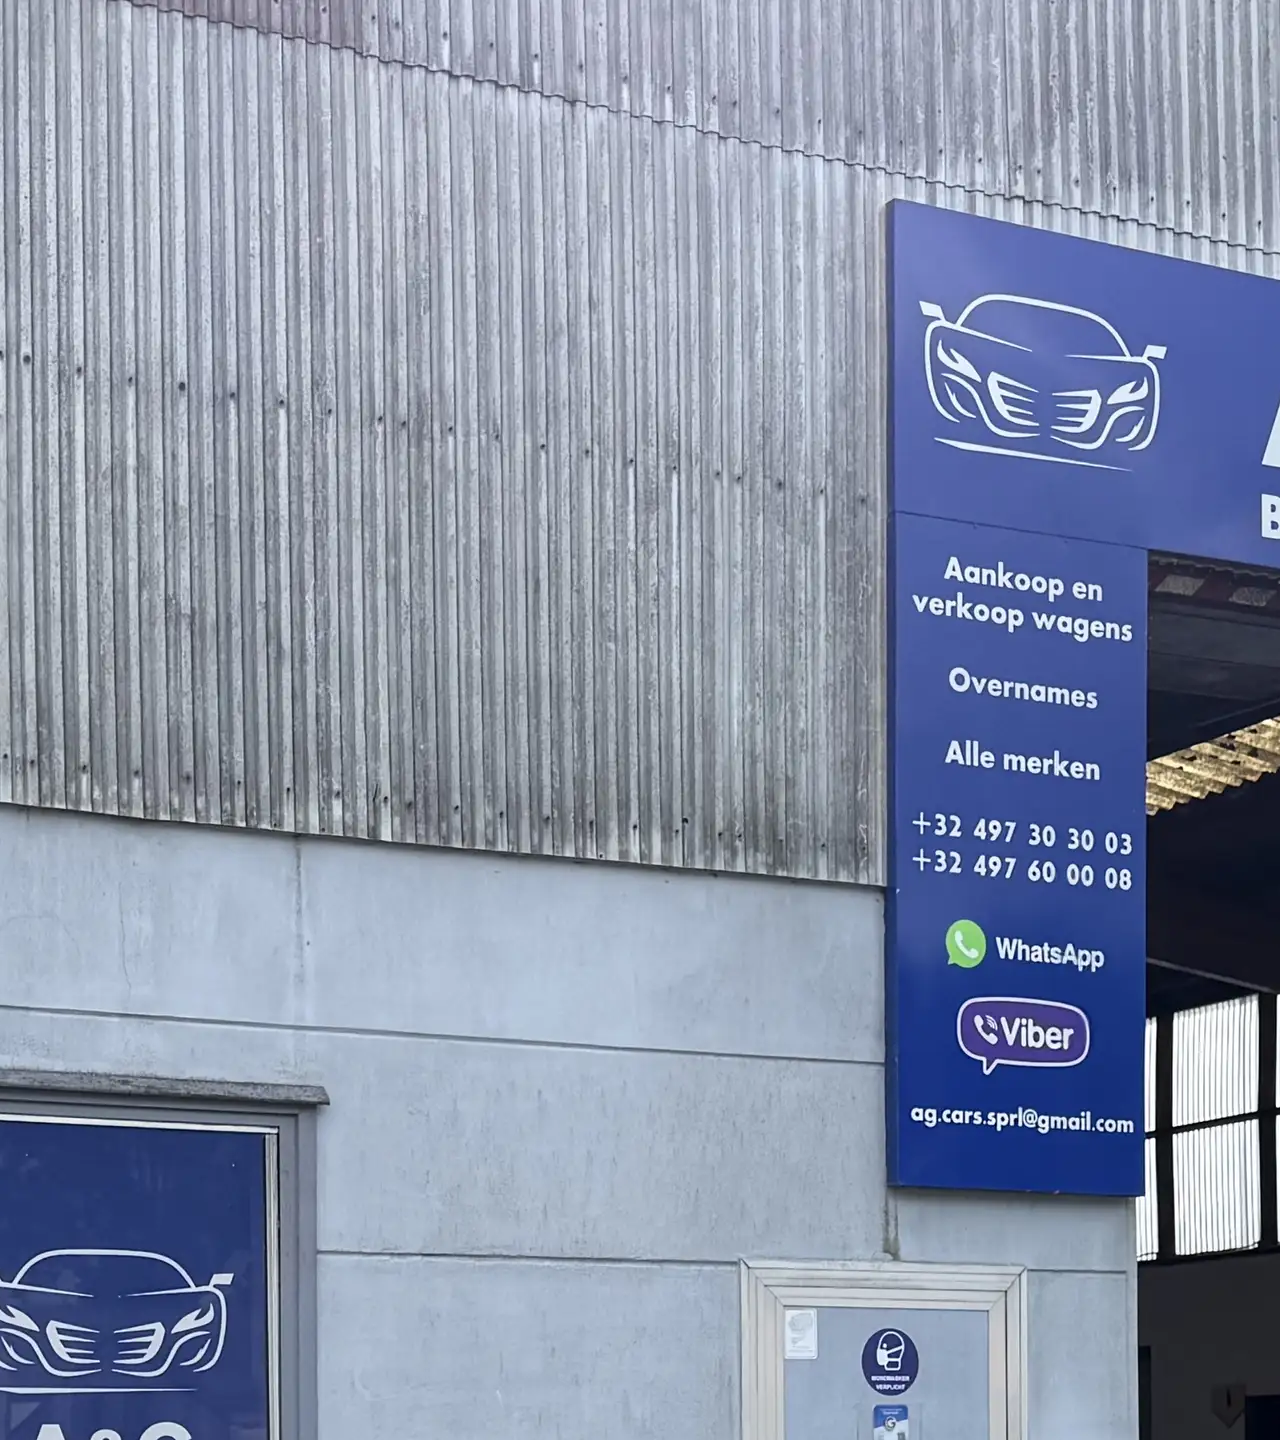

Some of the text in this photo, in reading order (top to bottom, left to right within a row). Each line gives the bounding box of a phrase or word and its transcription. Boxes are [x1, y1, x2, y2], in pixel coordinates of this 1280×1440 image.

[943, 556, 1103, 602] Aankoop en
[912, 591, 1133, 643] verkoop wagens
[948, 667, 1098, 709] Overnames
[944, 739, 1100, 781] Alle merken
[912, 811, 1133, 855] +32 497 30 30 03
[912, 848, 1132, 891] +32 497 60 00 08
[995, 936, 1105, 973] WhatsApp
[1000, 1016, 1075, 1050] Viber
[910, 1106, 1134, 1134] ag.cars.sprl@gmail.com
